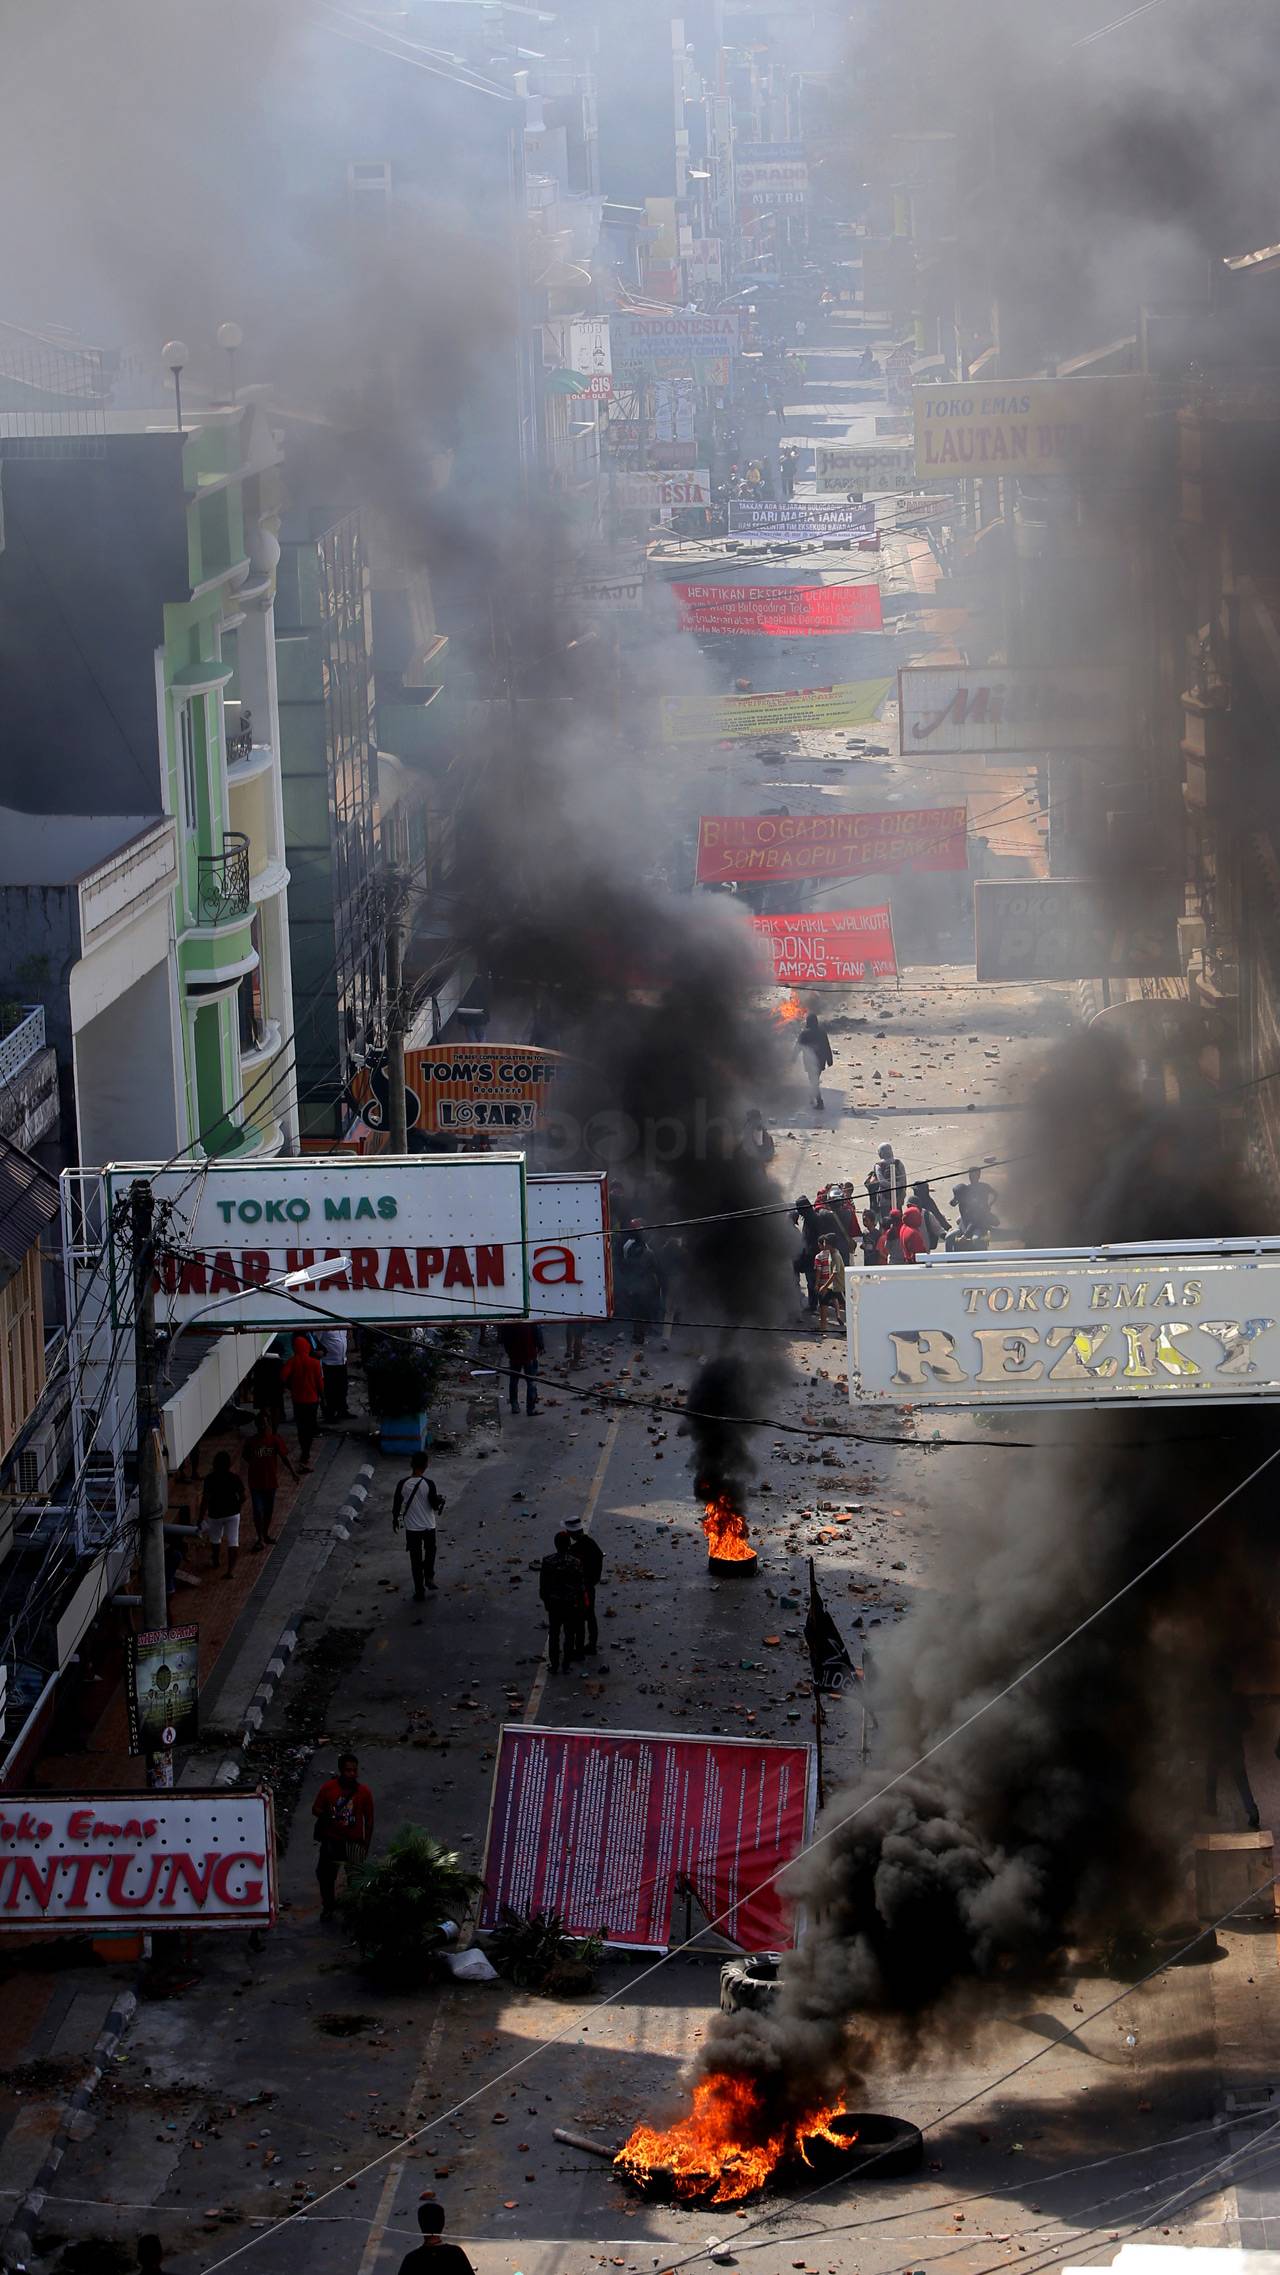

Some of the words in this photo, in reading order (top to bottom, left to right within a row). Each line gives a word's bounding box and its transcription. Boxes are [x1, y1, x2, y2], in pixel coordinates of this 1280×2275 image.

[630, 319, 735, 335] INDONESIA
[925, 400, 974, 418] TOKO
[981, 396, 1031, 415] EMAS
[924, 427, 1028, 464] LAUTAN
[752, 512, 778, 522] DARI
[781, 512, 816, 522] MAFIA
[819, 512, 853, 522] TANAH
[688, 587, 745, 600] HENTIKAN
[703, 817, 870, 848] BULOGADING
[784, 919, 829, 933] WAKIL
[421, 1063, 492, 1082] TOM'S
[473, 1086, 522, 1095] Roasters
[216, 1198, 311, 1223] TOKO
[324, 1195, 399, 1221] MAS
[286, 1243, 505, 1293] HARAPAN
[962, 1284, 1071, 1314] TOKO
[1088, 1280, 1204, 1311] EMAS
[888, 1318, 1278, 1386] REZKY
[67, 1808, 159, 1839] Emas
